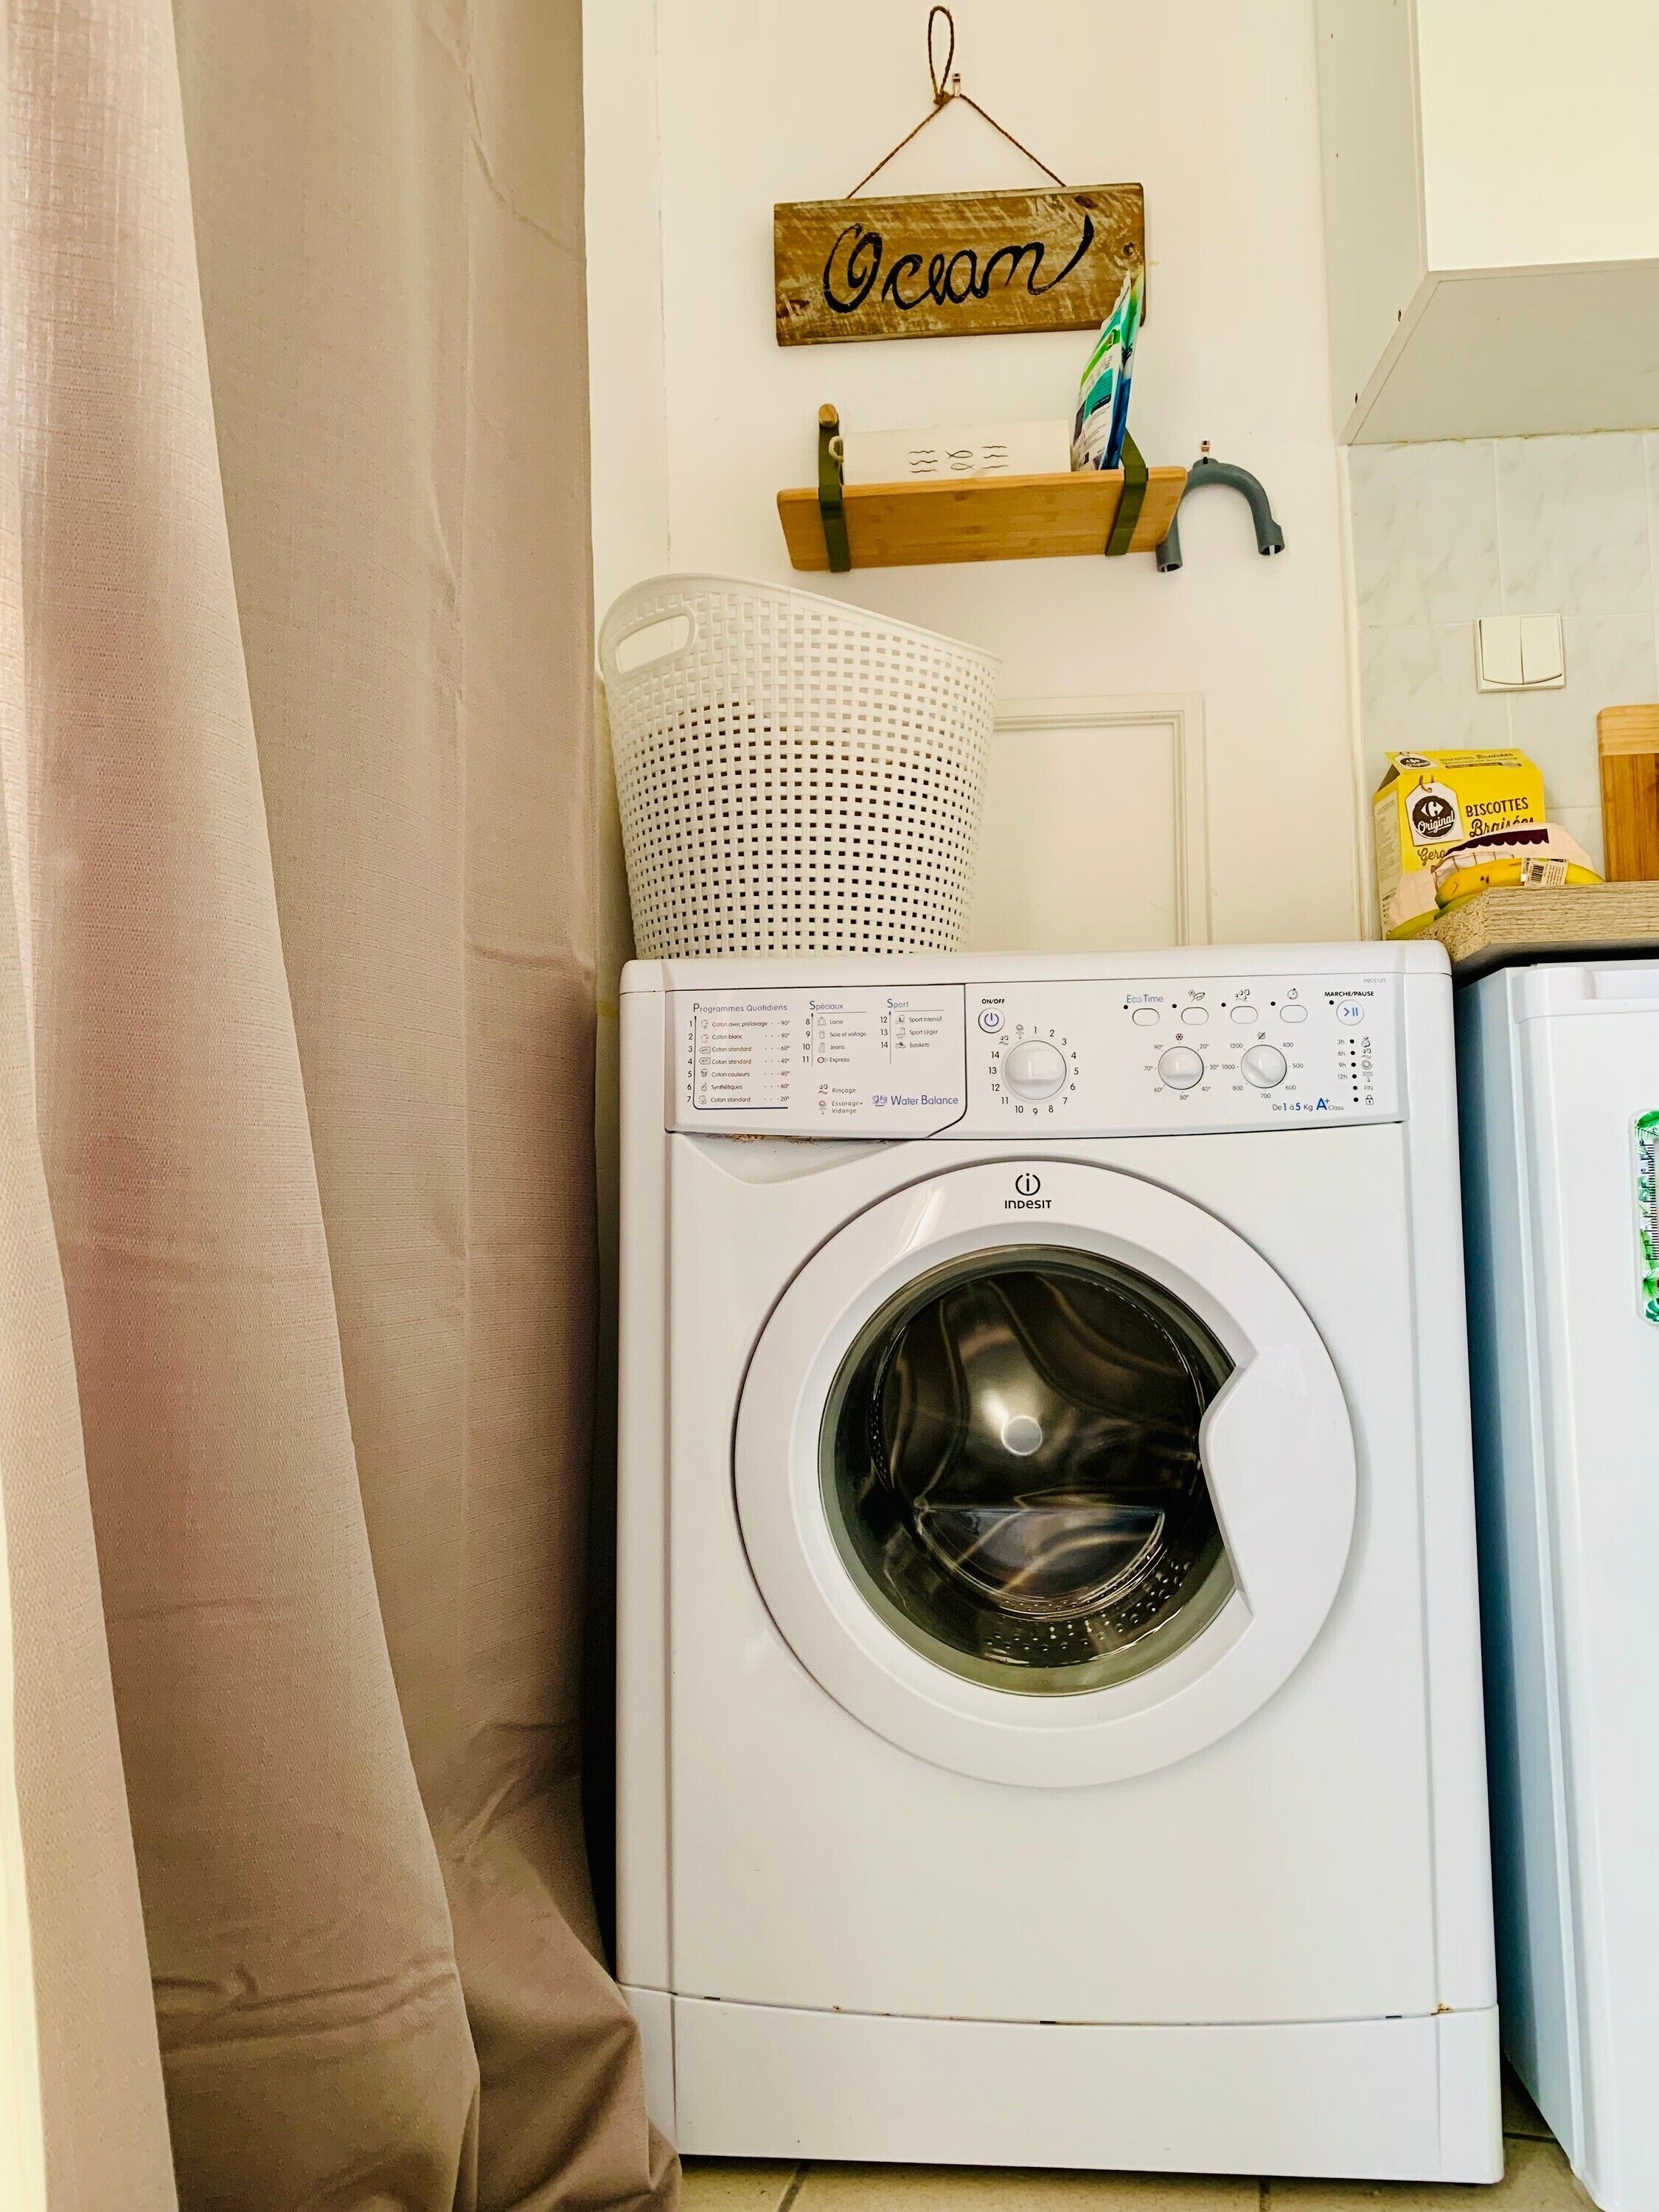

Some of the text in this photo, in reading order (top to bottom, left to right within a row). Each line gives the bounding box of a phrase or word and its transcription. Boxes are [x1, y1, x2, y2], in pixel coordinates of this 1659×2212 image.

[823, 214, 1094, 313] Ocean
[1466, 797, 1528, 817] BISCOTTES
[1418, 810, 1455, 834] Original
[693, 1003, 744, 1014] Programmes
[810, 1001, 844, 1011] Spéciaux
[887, 998, 908, 1009] Sport
[1049, 1029, 1055, 1037] 2
[891, 1095, 959, 1105] Water Balance
[1015, 1105, 1023, 1113] 10
[1048, 1105, 1054, 1113] 8
